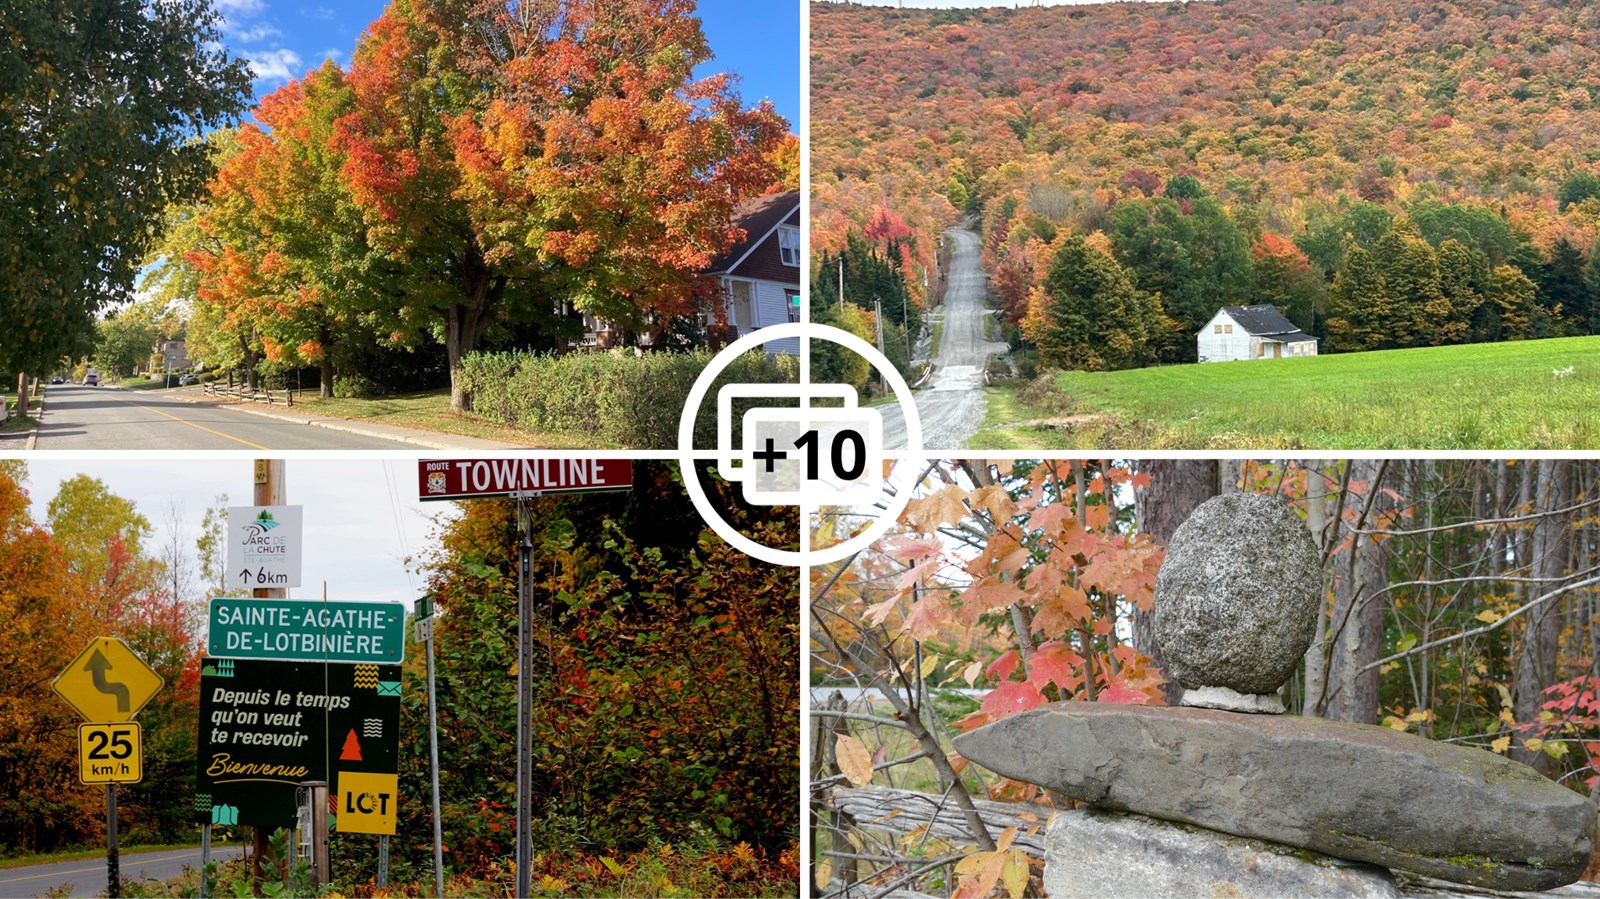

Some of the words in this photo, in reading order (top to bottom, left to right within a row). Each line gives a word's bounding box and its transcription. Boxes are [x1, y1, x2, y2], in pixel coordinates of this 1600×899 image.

[426, 461, 450, 471] ROUTE
[456, 459, 606, 492] TOWNLINE
[242, 526, 271, 545] PARC
[273, 536, 286, 545] DE
[243, 546, 255, 554] LA
[257, 545, 286, 554] CHUTE
[226, 631, 384, 655] DE-LOTBINIÈRE
[212, 688, 271, 707] Depuis
[275, 690, 291, 706] le
[296, 691, 351, 712] temps
[211, 709, 258, 726] qu'on
[264, 711, 303, 727] veut
[88, 730, 133, 760] 25
[211, 728, 228, 744] te
[233, 731, 309, 747] recevoir
[92, 762, 130, 776] km/h
[206, 753, 309, 777] Bienvenue
